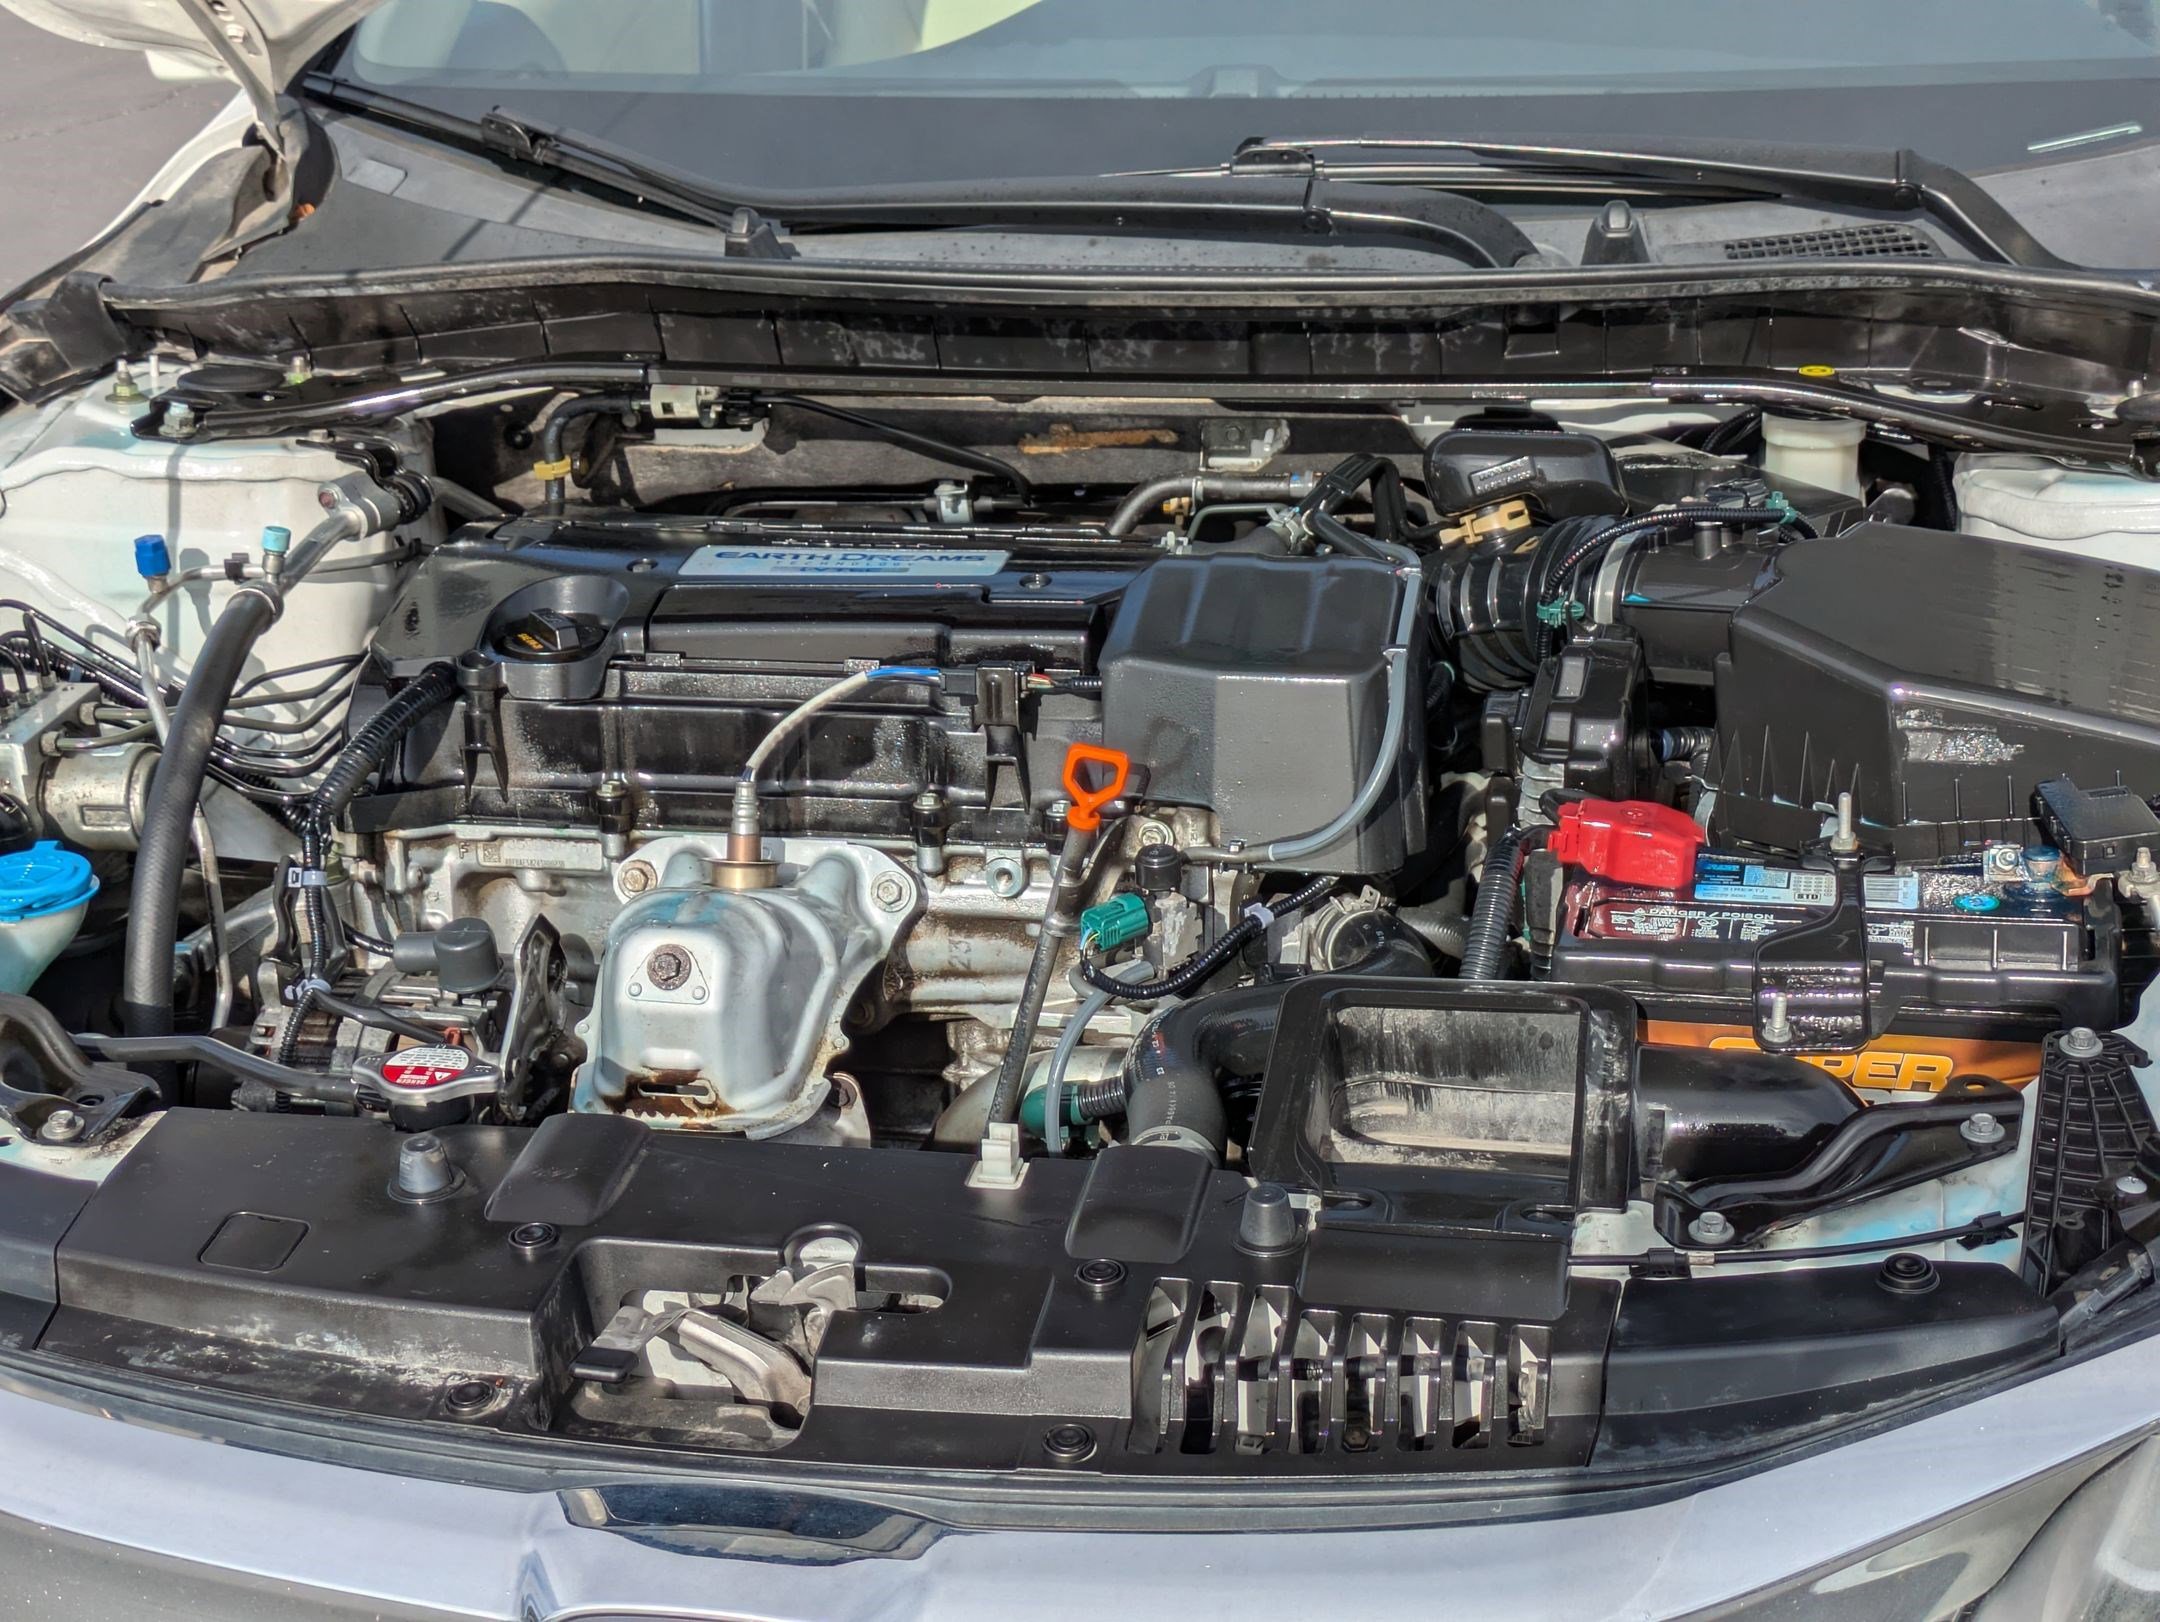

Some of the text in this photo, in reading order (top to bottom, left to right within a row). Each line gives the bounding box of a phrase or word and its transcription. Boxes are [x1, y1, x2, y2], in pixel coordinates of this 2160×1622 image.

[714, 552, 987, 562] EARTH DREAMS
[1649, 907, 1706, 917] DANGER
[1722, 912, 1774, 920] POISON
